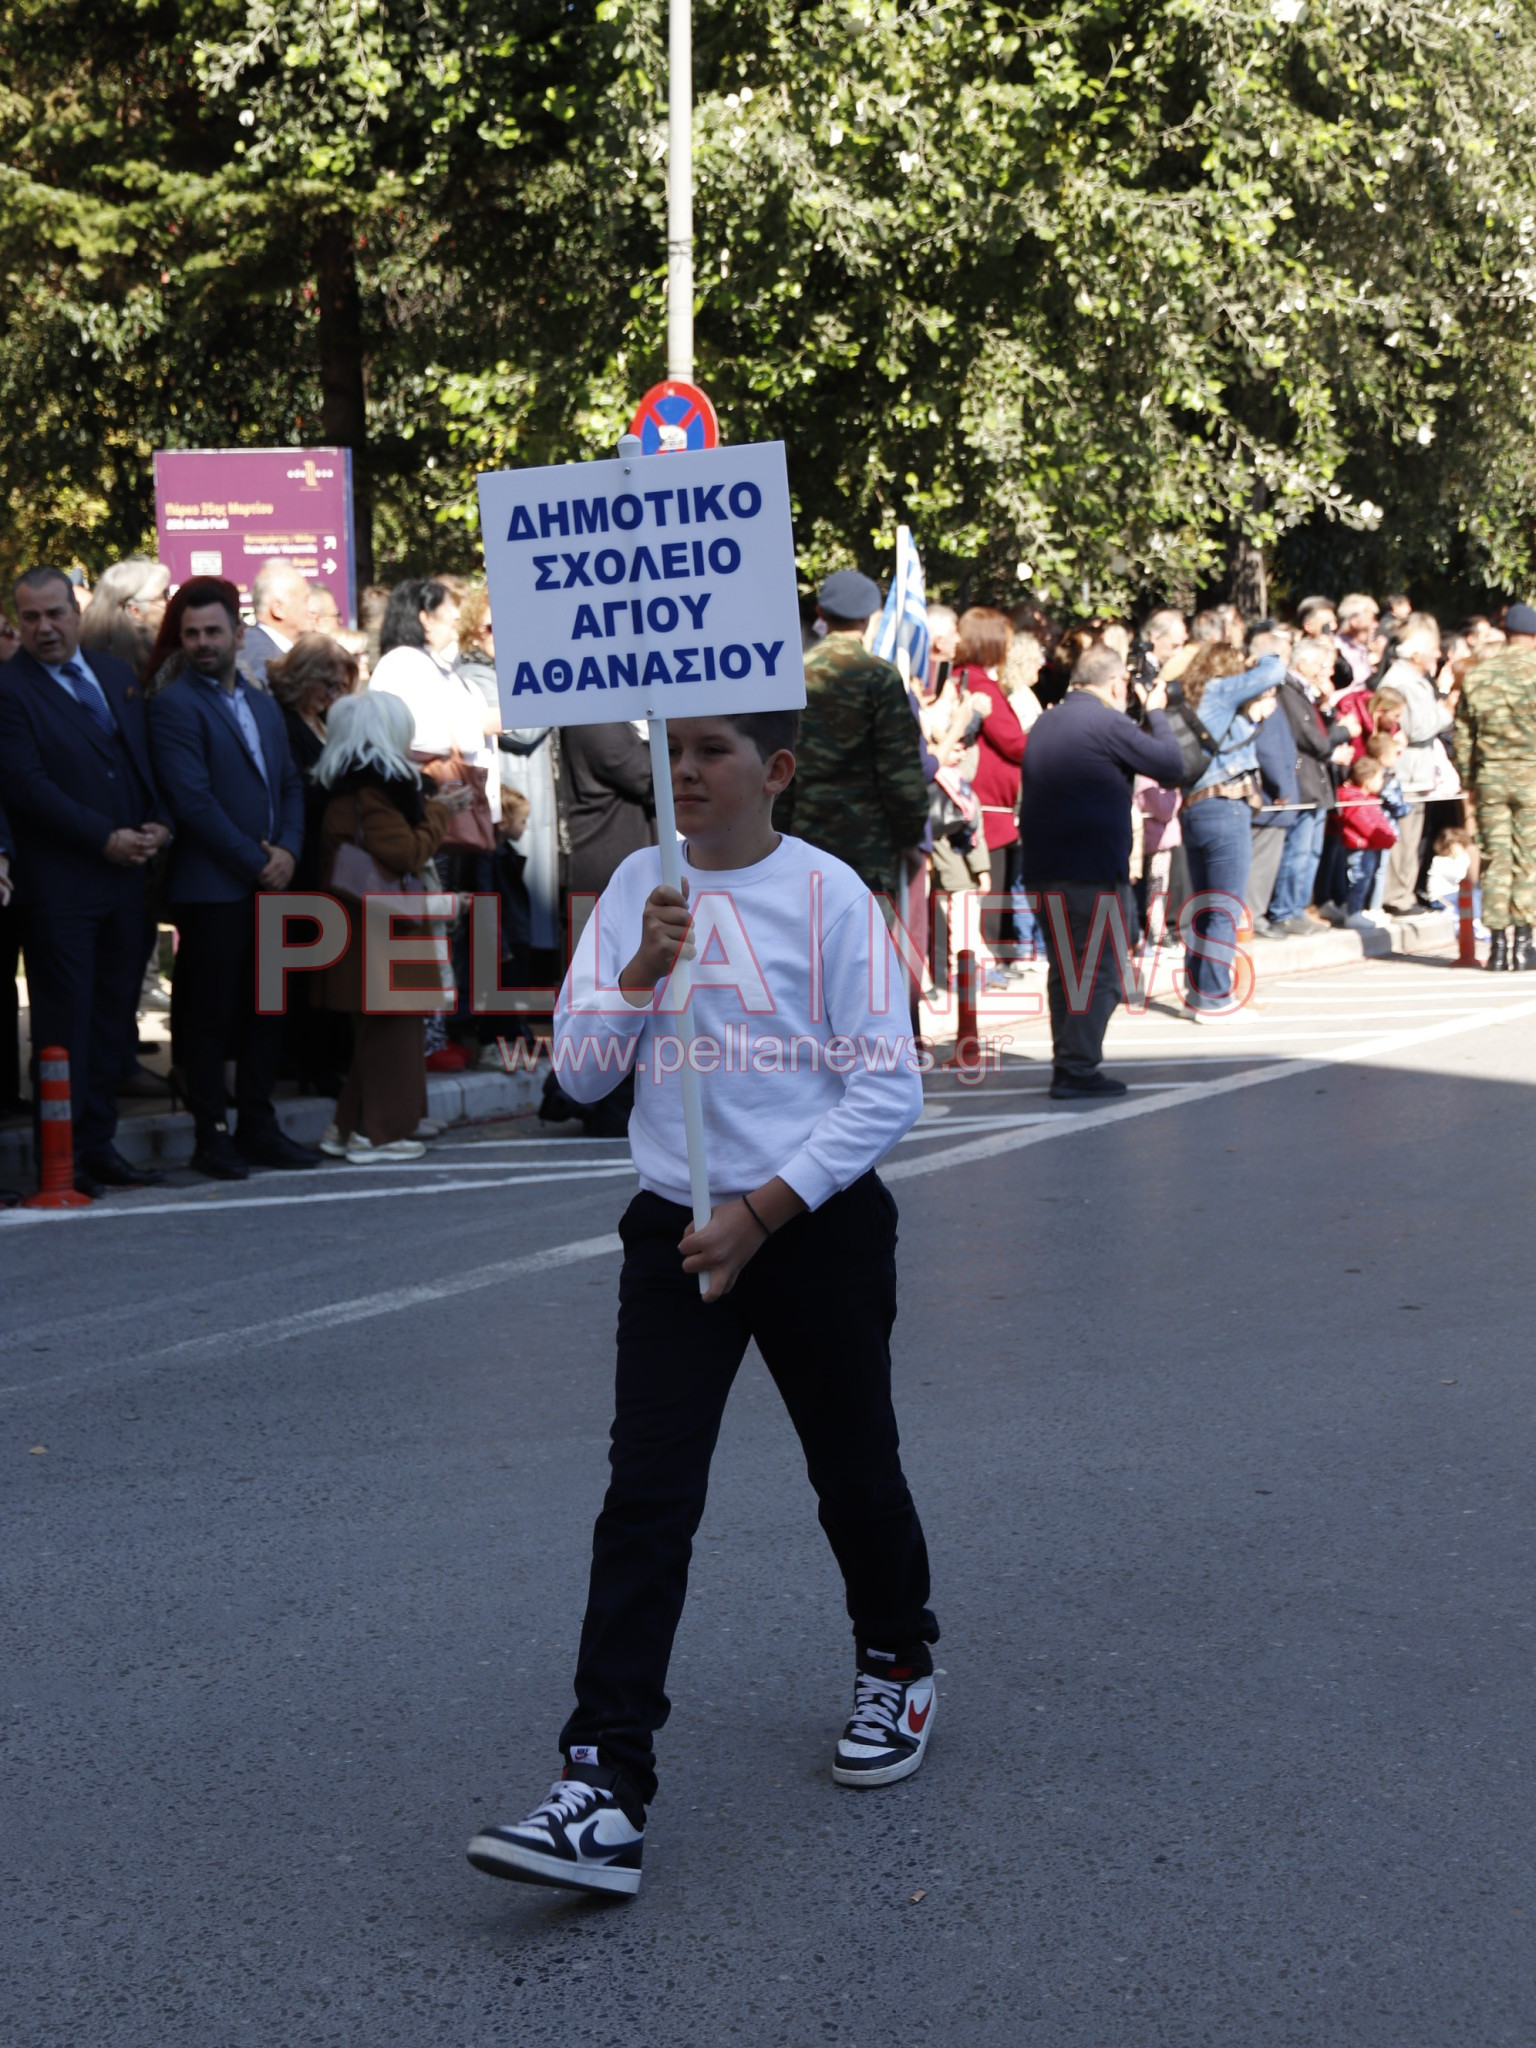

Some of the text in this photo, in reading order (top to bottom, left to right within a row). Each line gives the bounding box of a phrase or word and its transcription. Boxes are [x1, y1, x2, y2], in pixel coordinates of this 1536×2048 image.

[507, 481, 762, 542] ΔΗΜΟΤΙΚΟ
[532, 537, 741, 591] ΣΧΟΛΕΙΟ
[571, 593, 712, 641] ΑΓΙΟΥ
[511, 640, 785, 696] ΑΘΑΝΑΣΙΟΥ
